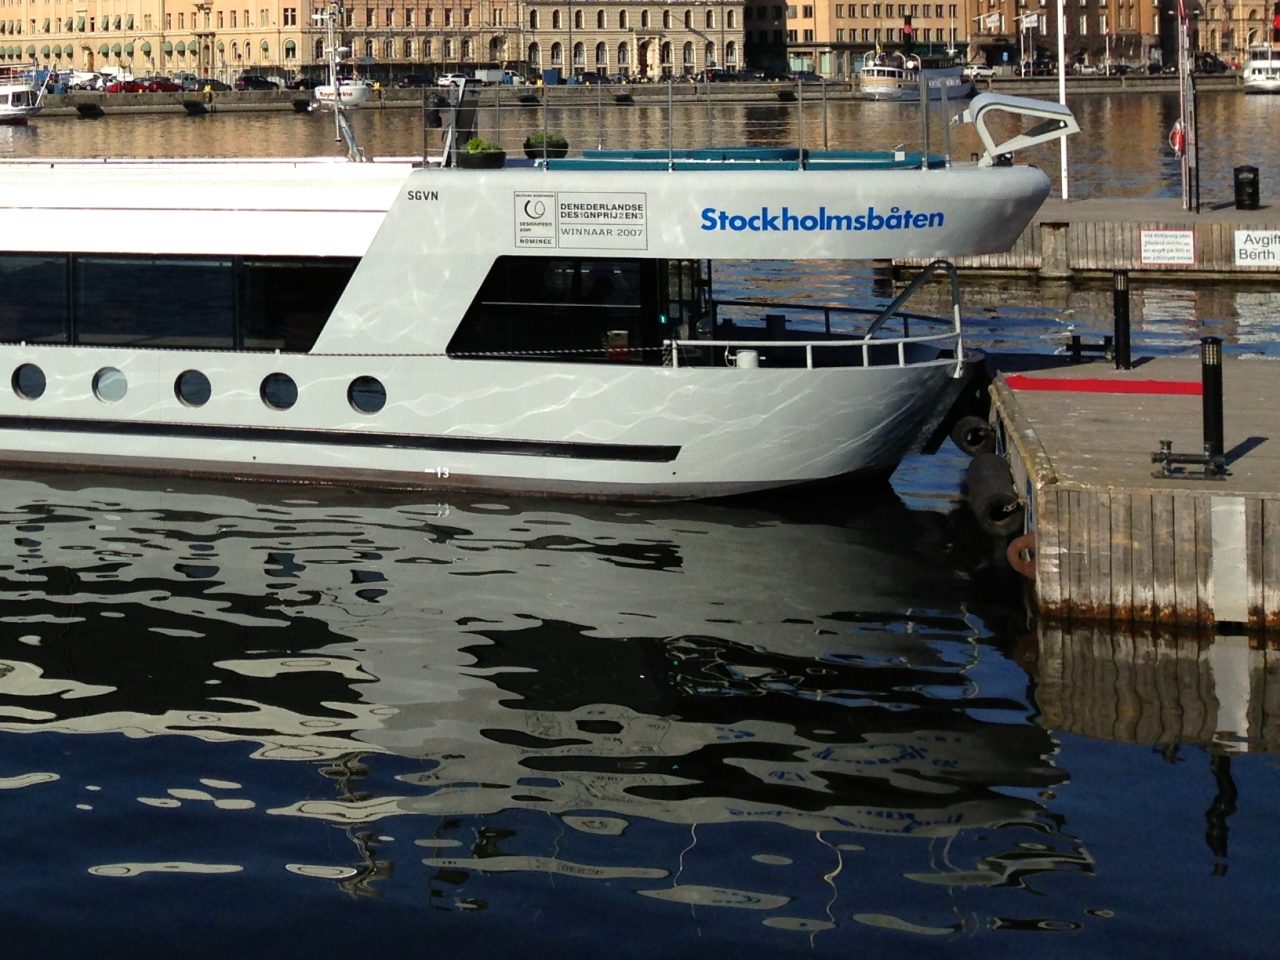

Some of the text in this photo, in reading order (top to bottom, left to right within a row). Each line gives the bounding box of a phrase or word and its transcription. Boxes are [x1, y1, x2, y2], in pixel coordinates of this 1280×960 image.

[407, 190, 439, 201] SGVN
[700, 206, 945, 232] Stockholmsbåten
[560, 228, 643, 237] WINNAAR 2007
[1239, 248, 1275, 260] Berth
[437, 466, 449, 478] 13
